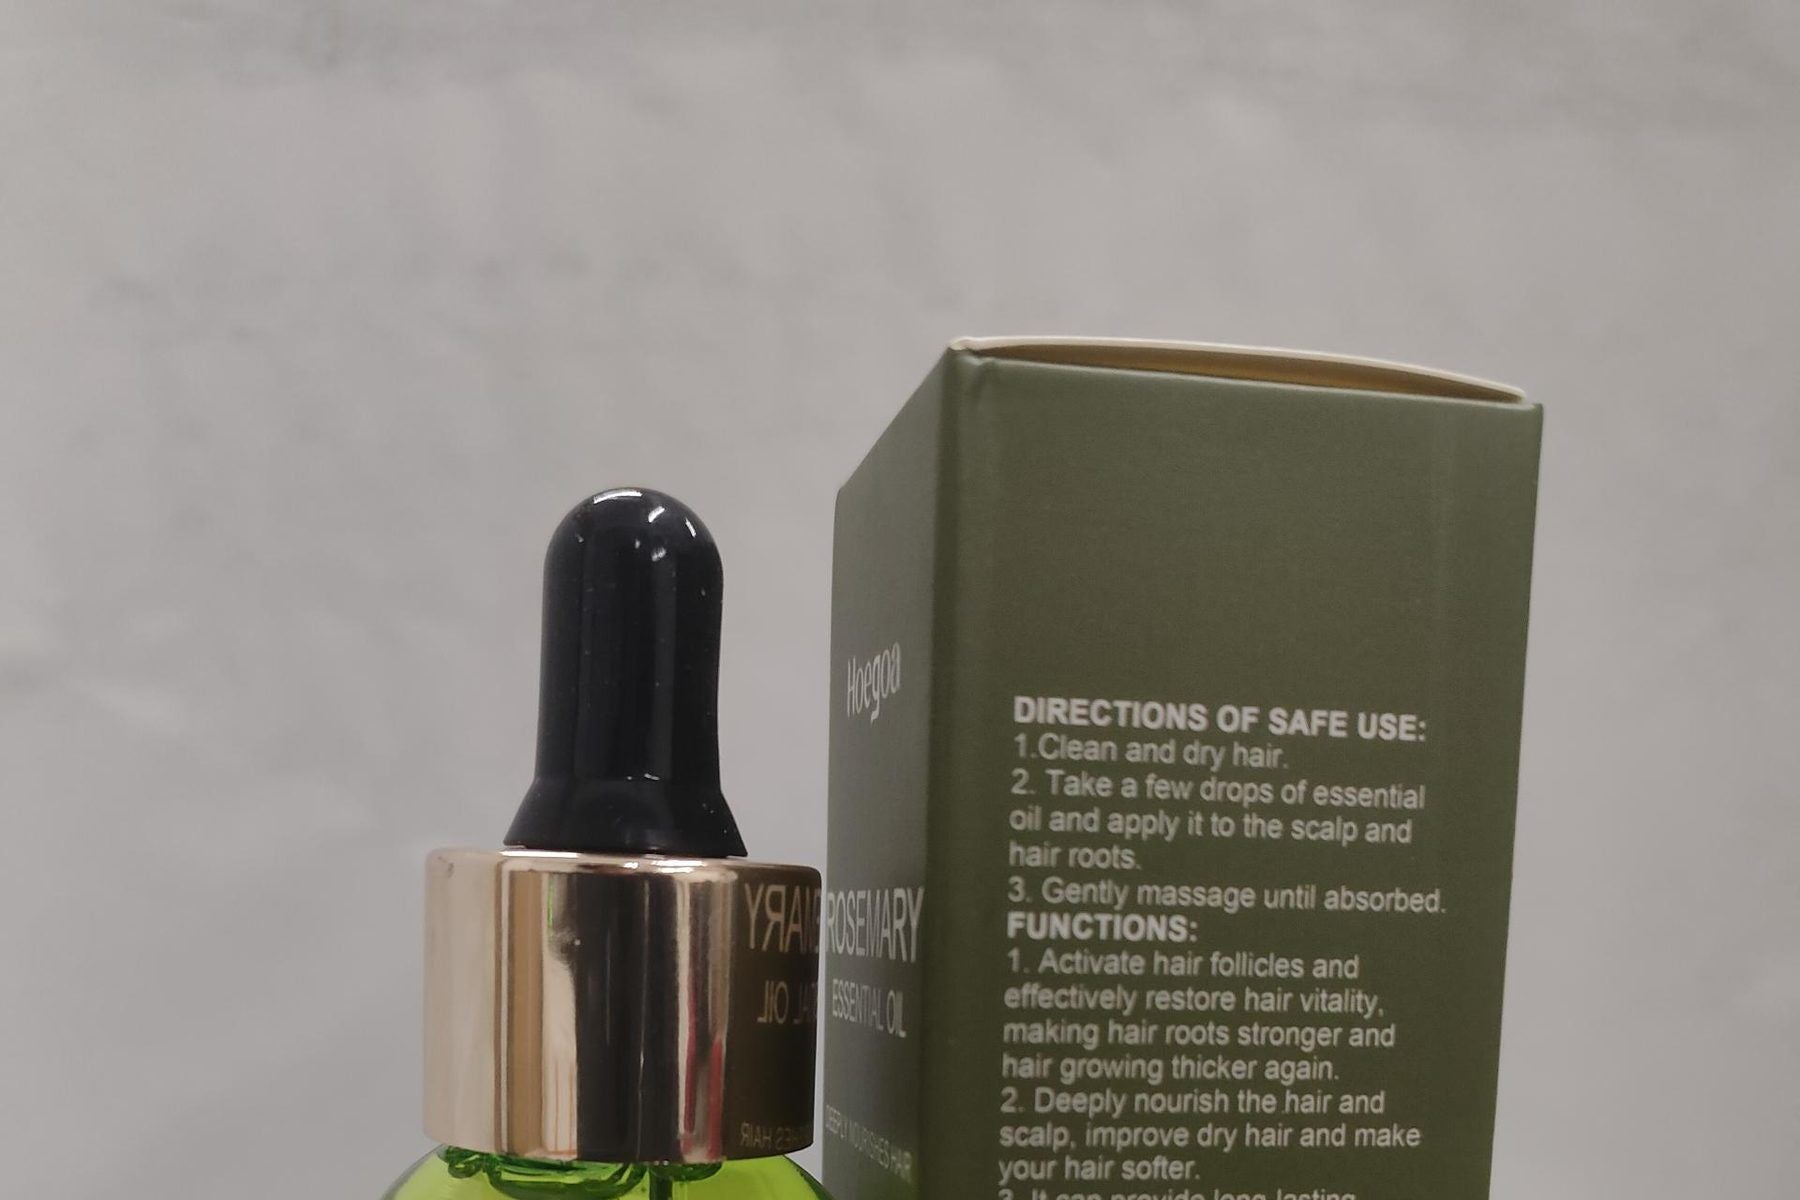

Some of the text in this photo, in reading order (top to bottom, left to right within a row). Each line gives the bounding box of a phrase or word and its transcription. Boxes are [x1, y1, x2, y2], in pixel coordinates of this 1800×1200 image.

[847, 641, 901, 724] Hoegoa
[1014, 696, 1426, 741] DIRECTIONS OF SAFE USE:
[1014, 733, 1289, 772] 1.Clean and dry hair.
[1046, 769, 1426, 809] Take a few drops of essential
[1010, 804, 1412, 847] oil and apply the scalp and
[1009, 841, 1141, 870] hair roots.
[1042, 877, 1446, 914] Gently massage until absorbed.
[825, 885, 925, 963] ROSEMARY
[1007, 911, 1197, 942] FUNCTIONS:
[1039, 948, 1360, 979] Activate hair follicles and
[832, 978, 884, 1032] ESSENTIAL
[886, 991, 907, 1038] OIL
[1004, 984, 1384, 1018] effectively restore hair vitality,
[1003, 1018, 1395, 1052] making hair roots stronger and
[1003, 1053, 1339, 1086] hair growing thicker again.
[1034, 1088, 1385, 1118] Deeply nourish the hair and
[1000, 1122, 1422, 1152] scalp, improve dry hair and make
[999, 1155, 1200, 1185] your hair softer.
